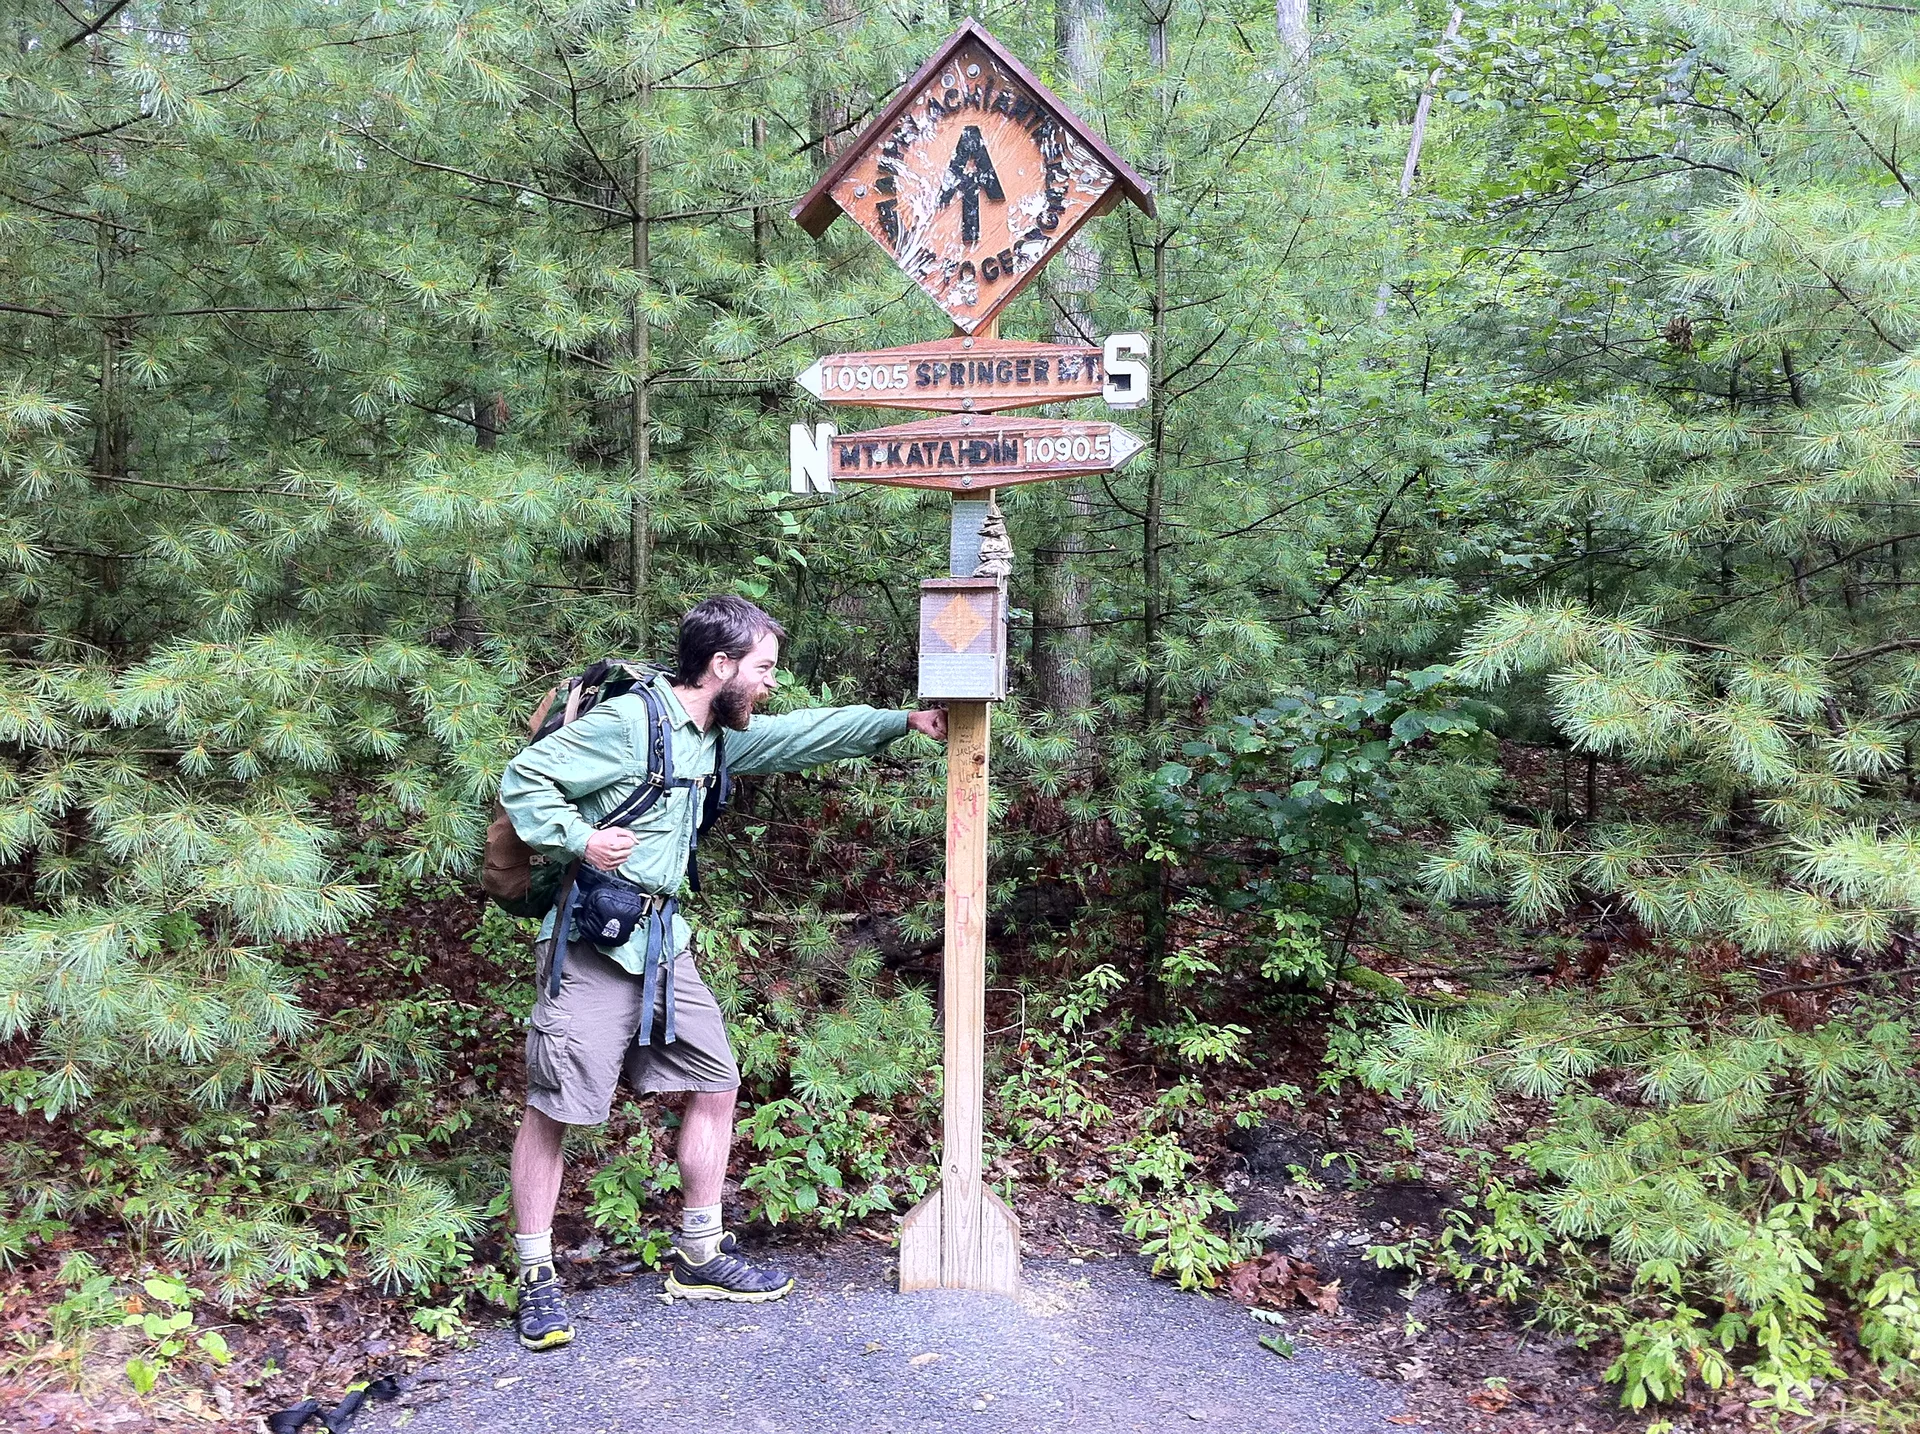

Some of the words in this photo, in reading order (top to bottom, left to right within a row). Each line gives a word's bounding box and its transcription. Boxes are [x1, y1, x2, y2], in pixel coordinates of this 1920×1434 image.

[915, 359, 1051, 386] SPRINGER
[1103, 332, 1151, 409] S
[790, 422, 838, 494] N
[887, 438, 1018, 468] KATAHDIN
